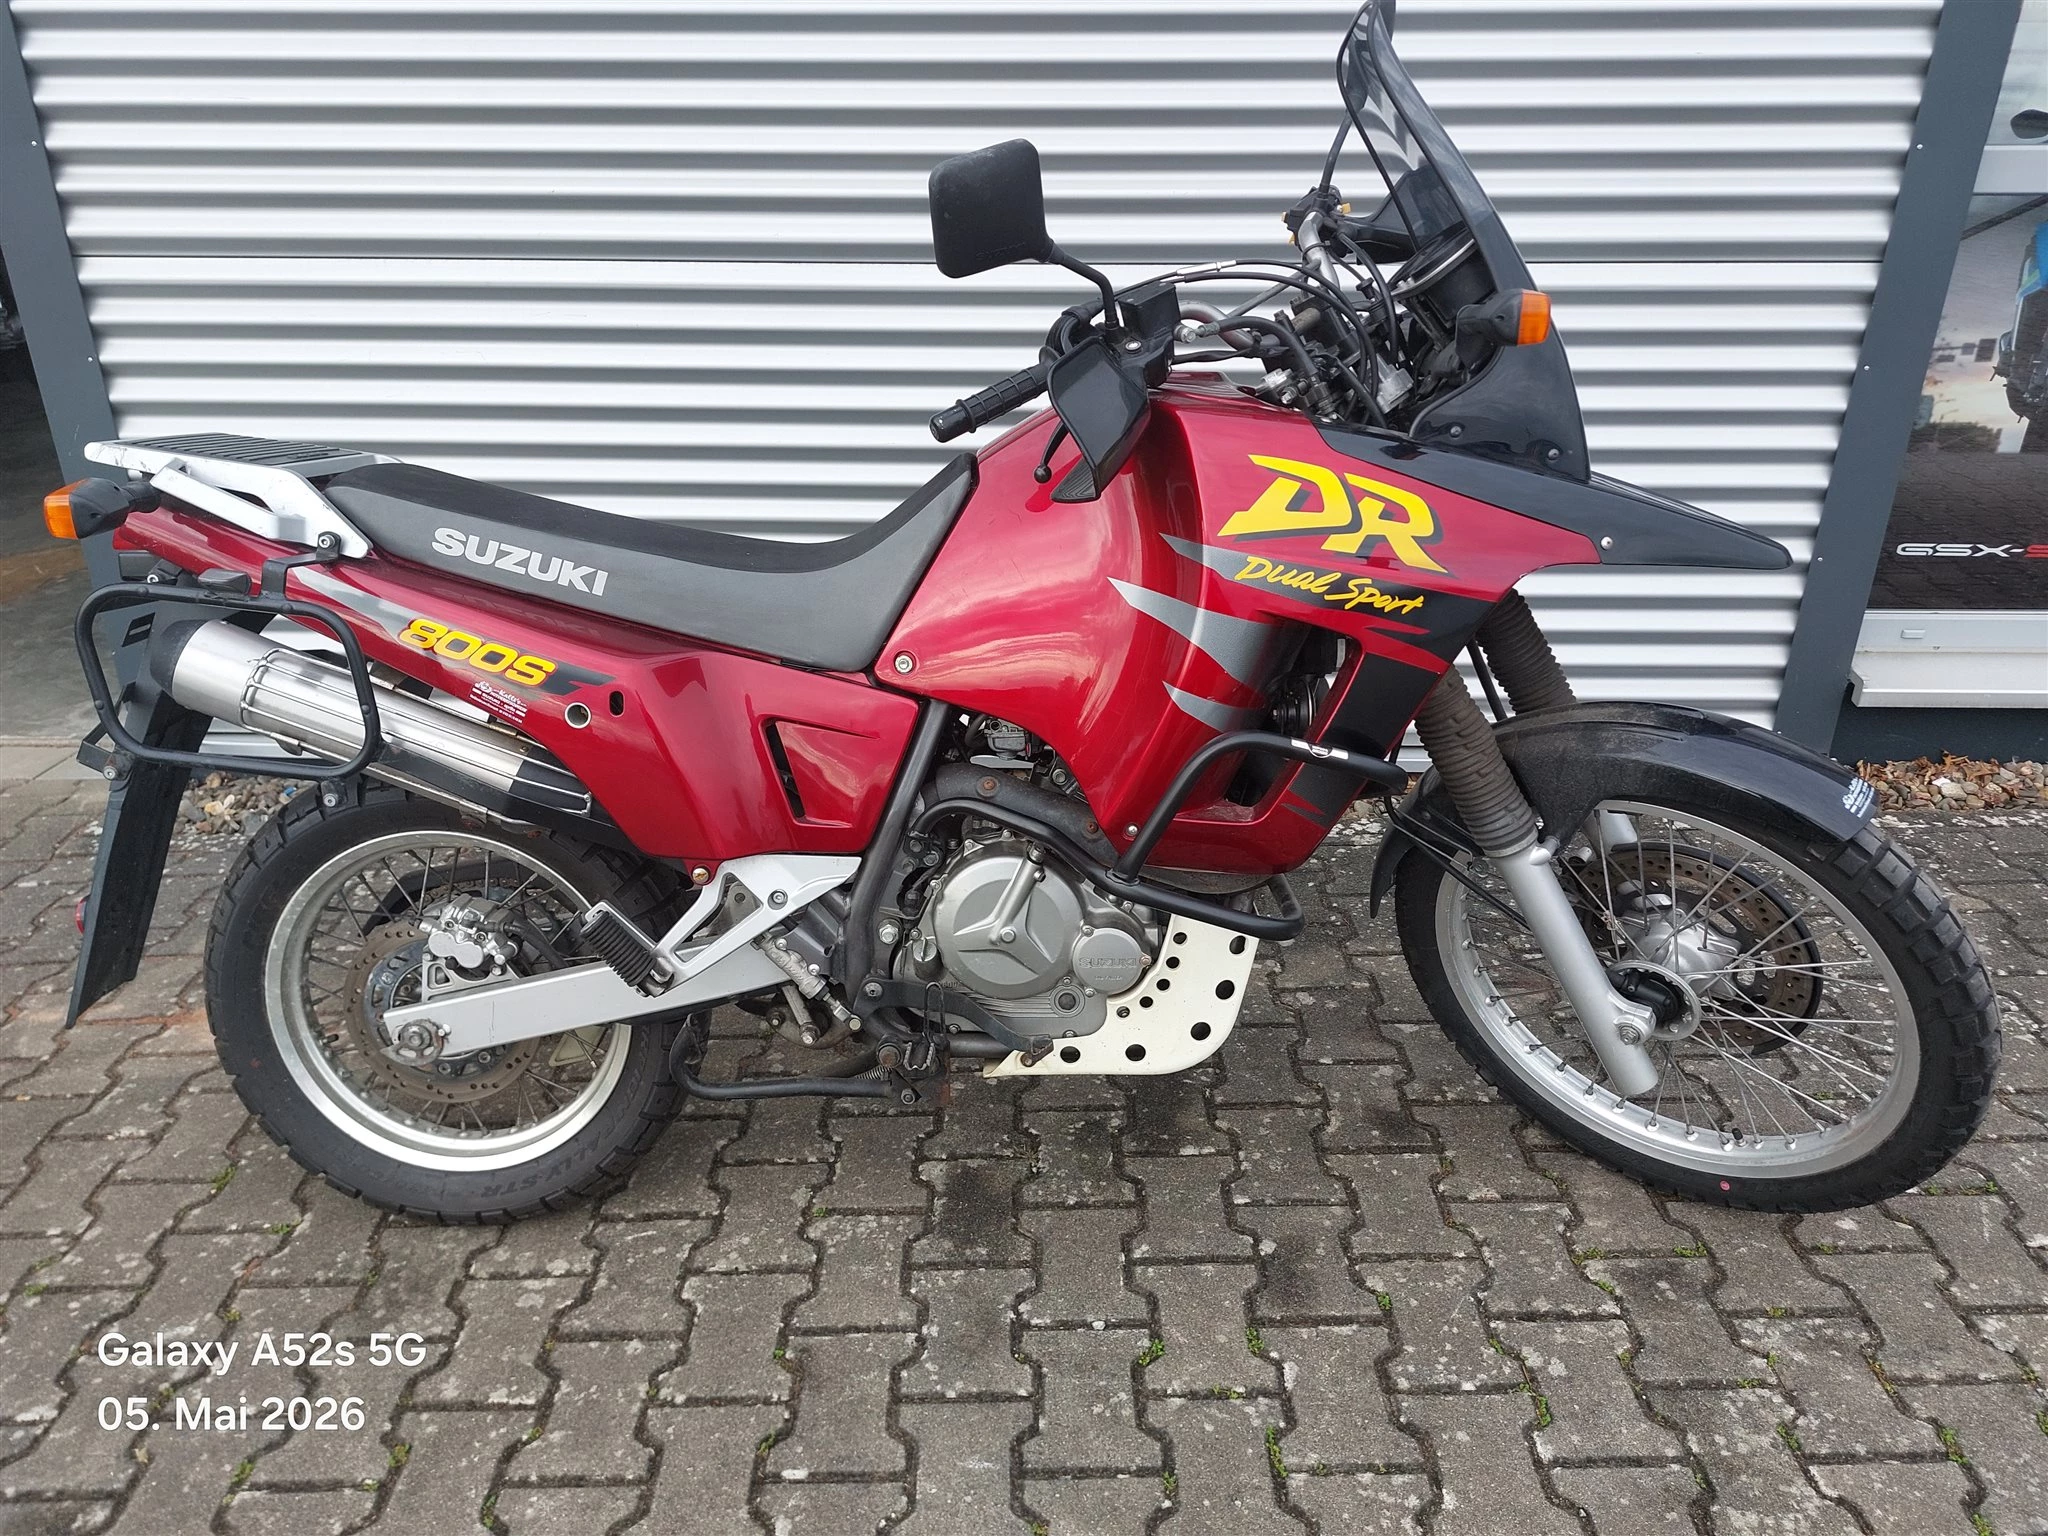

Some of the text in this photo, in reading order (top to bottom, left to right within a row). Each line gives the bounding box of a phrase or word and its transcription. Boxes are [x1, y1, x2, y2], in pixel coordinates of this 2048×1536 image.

[1217, 454, 1449, 574] DR
[431, 527, 609, 597] SUZUKI
[1234, 555, 1425, 615] Dual Sport
[399, 617, 558, 687] 800S
[1079, 957, 1137, 968] SUZUKI
